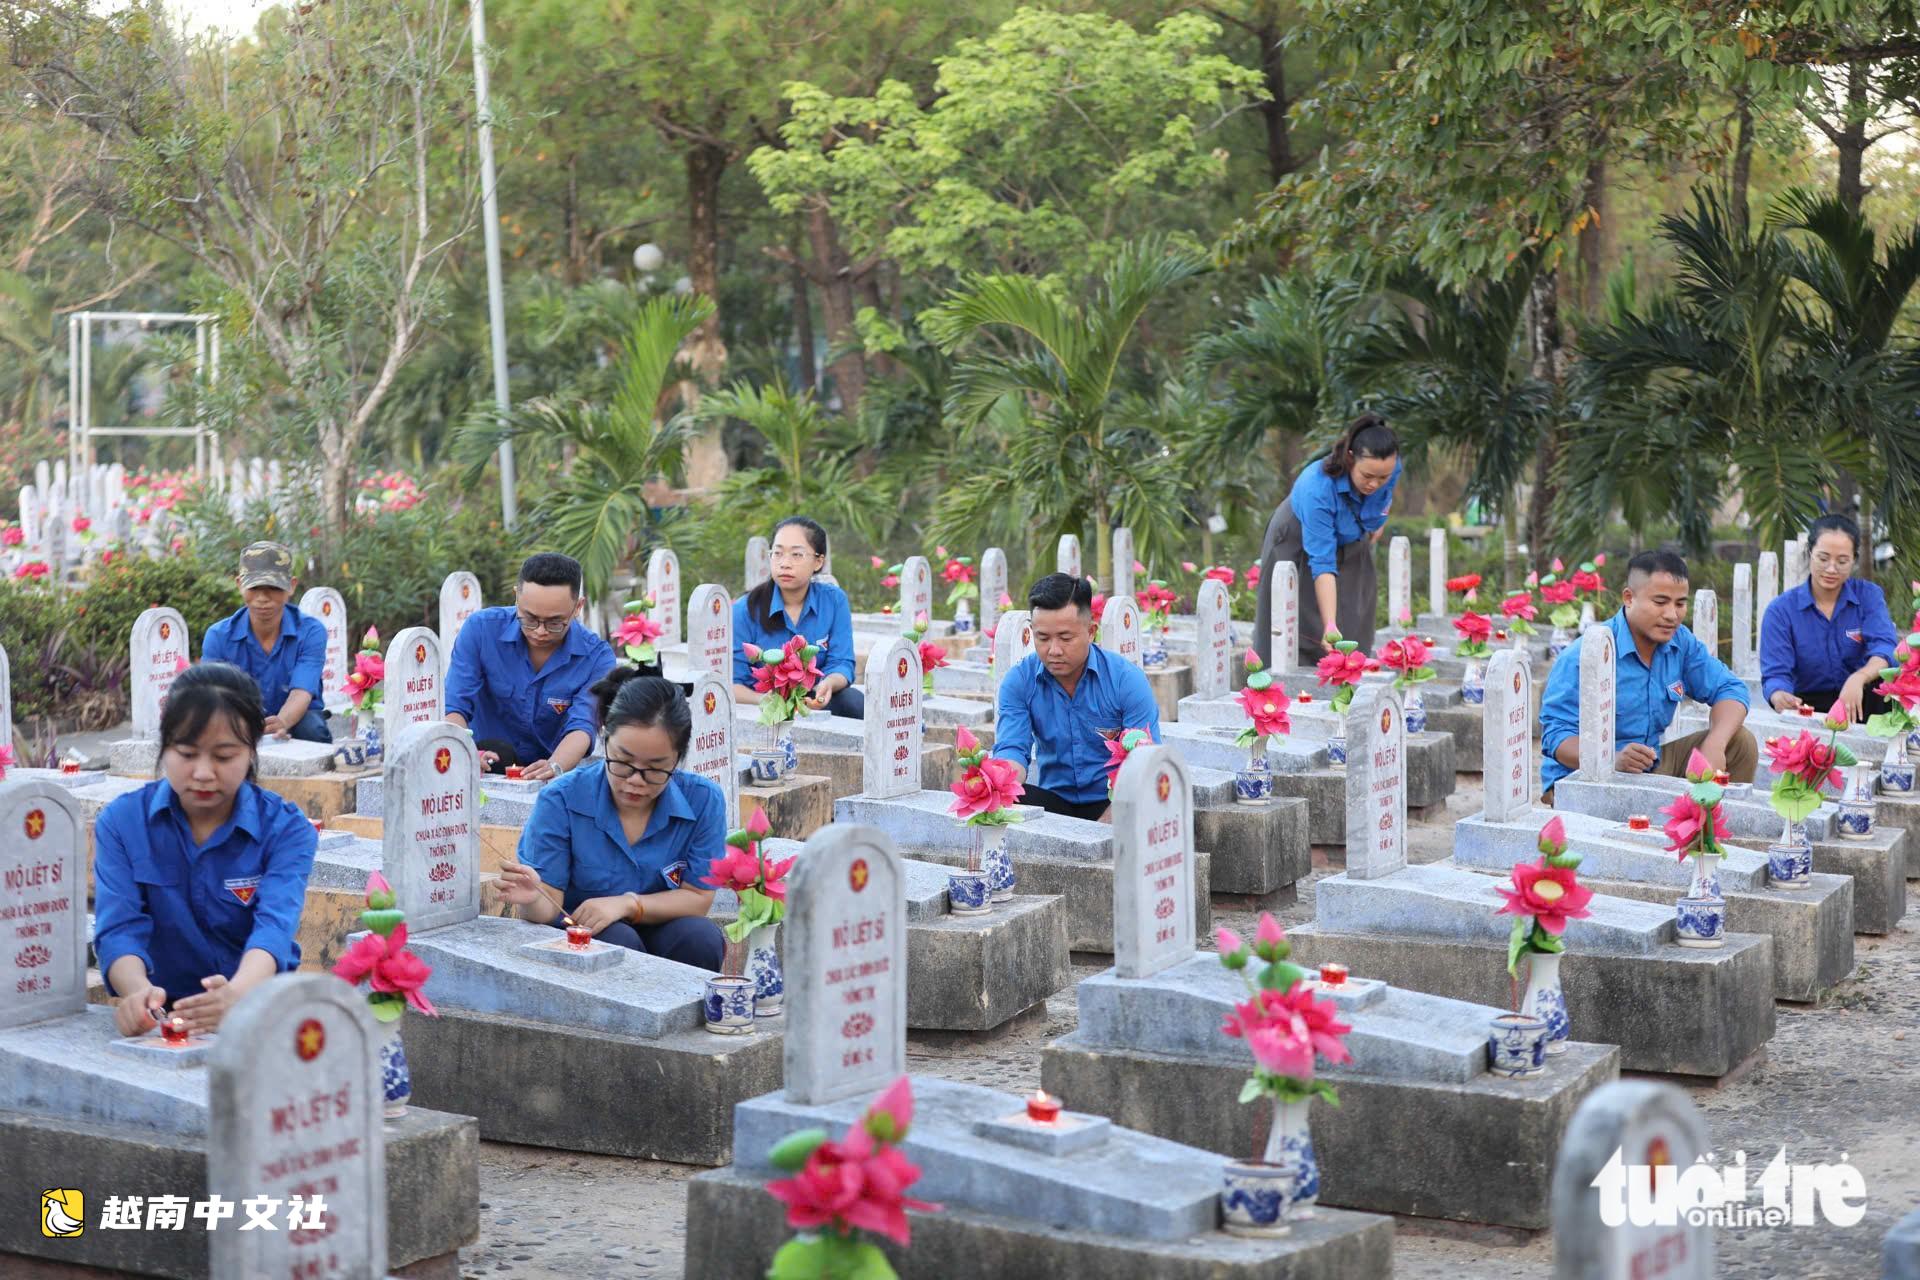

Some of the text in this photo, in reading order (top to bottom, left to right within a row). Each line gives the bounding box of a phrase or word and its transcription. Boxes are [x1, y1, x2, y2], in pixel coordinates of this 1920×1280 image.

[695, 732, 705, 755] MỘ
[421, 788, 464, 819] MỘ LIỆT SĨ
[5, 857, 63, 895] MỘ LIỆT SĨ
